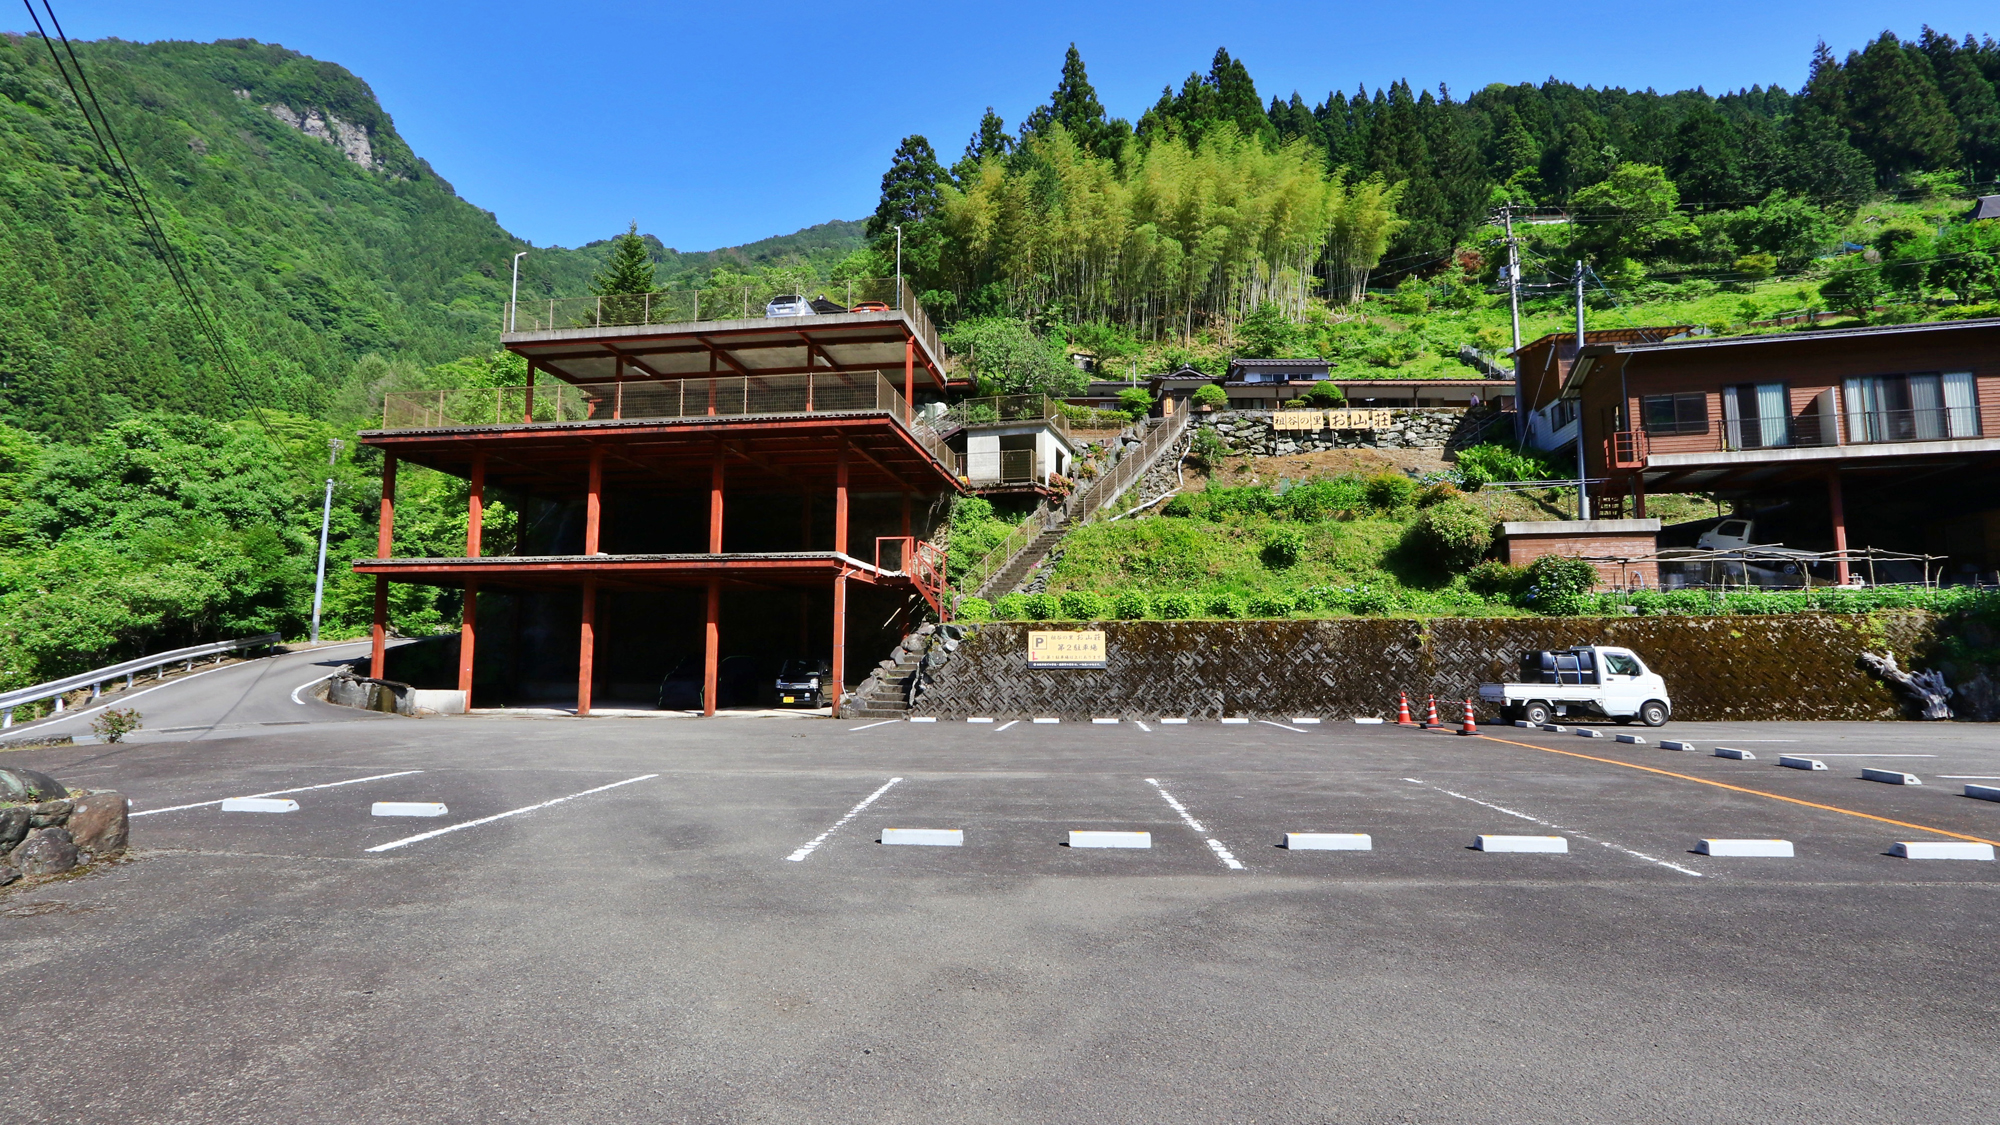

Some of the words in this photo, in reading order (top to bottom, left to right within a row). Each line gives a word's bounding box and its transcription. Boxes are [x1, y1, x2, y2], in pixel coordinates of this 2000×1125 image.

[1274, 415, 1322, 426] 祖谷の里
[1332, 412, 1388, 427] お山荘
[1035, 637, 1044, 648] P
[1077, 633, 1101, 641] お山荘
